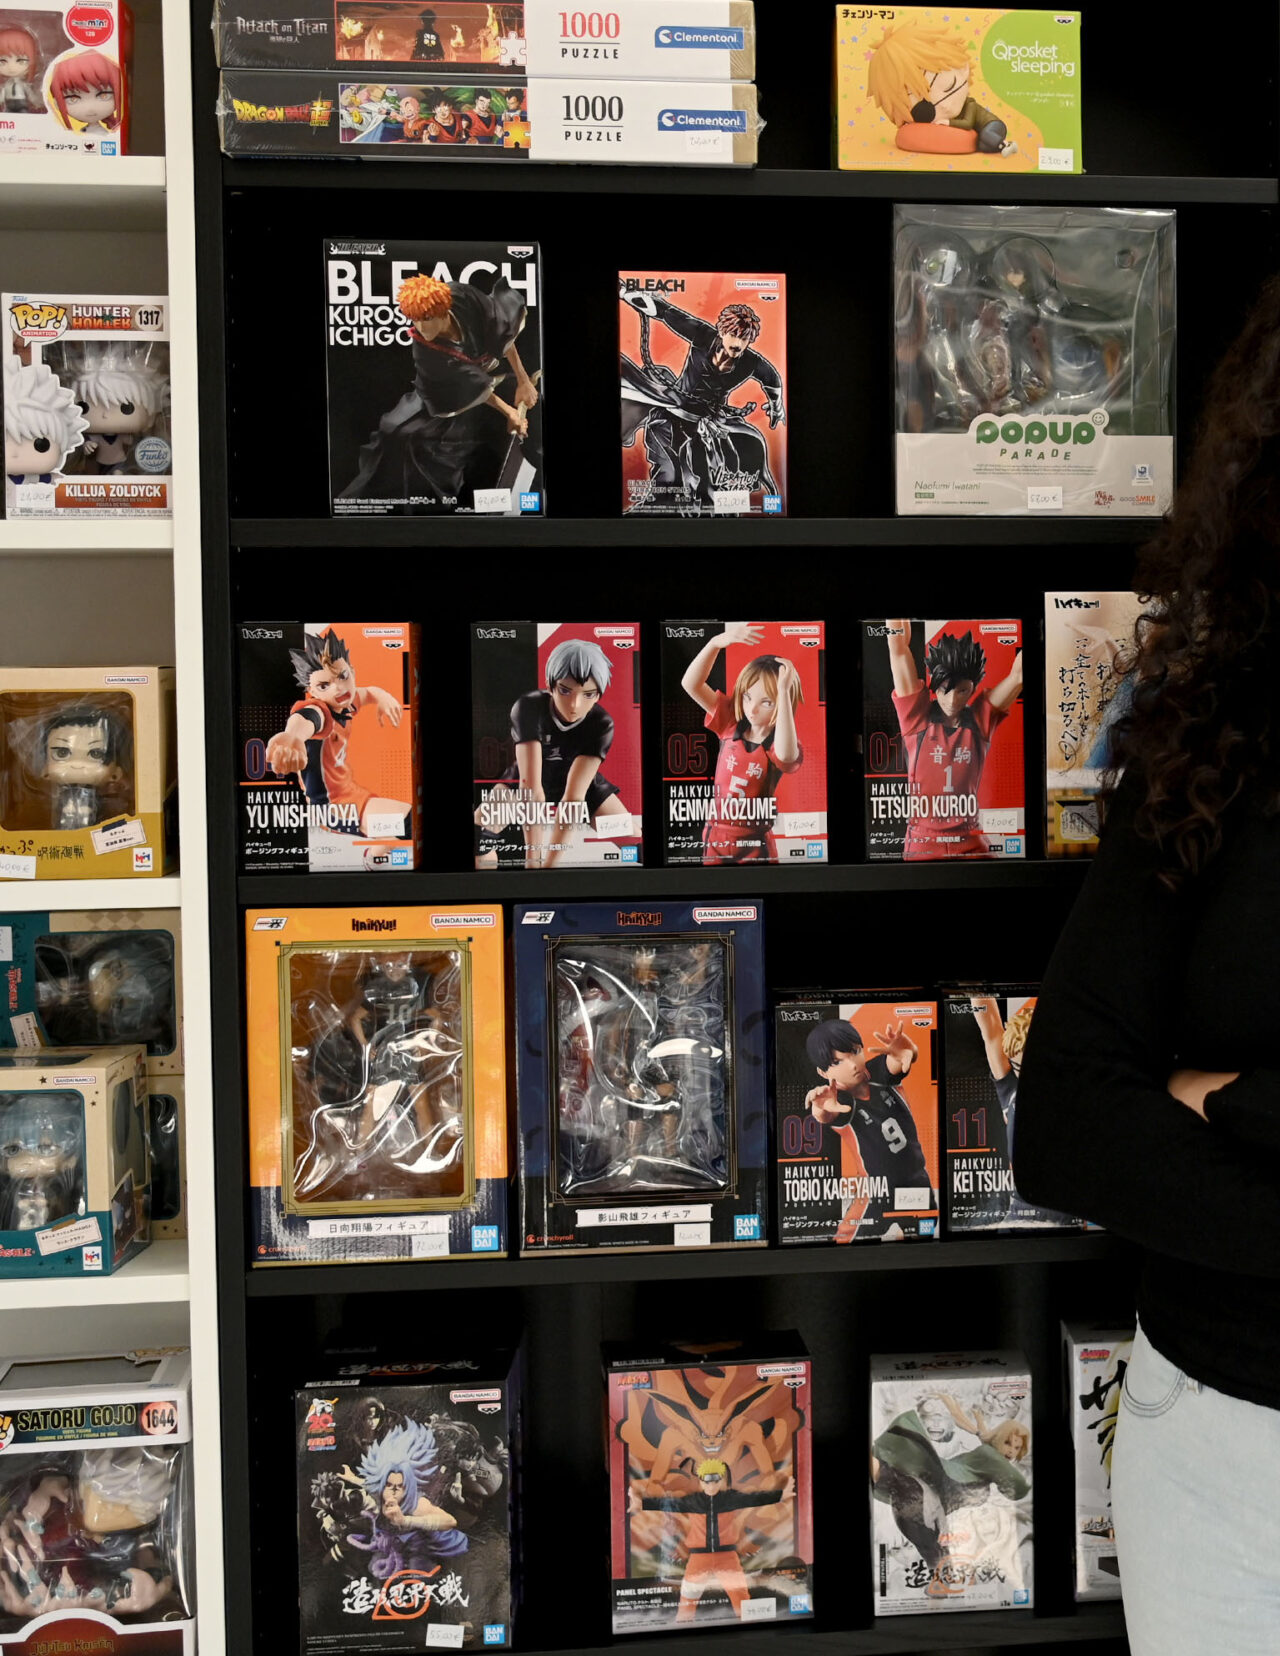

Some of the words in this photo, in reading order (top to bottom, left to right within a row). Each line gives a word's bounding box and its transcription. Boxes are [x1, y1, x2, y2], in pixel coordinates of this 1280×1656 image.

[842, 9, 895, 20] チェンソーマン
[236, 16, 279, 34] Attack
[282, 24, 292, 32] on
[294, 18, 328, 34] Titan
[558, 12, 620, 38] 1000
[674, 32, 738, 43] Clementoni
[562, 48, 618, 59] PUZZLE
[1012, 60, 1076, 76] sleeping
[233, 98, 284, 122] DRAGON
[563, 95, 624, 121] 1000
[677, 115, 741, 126] Clementoni
[565, 131, 622, 141] PUZZLE
[626, 279, 685, 292] BLEACH
[11, 304, 66, 330] POP!
[72, 305, 130, 317] HUNTER
[138, 310, 160, 326] 1317
[976, 420, 1096, 444] POPUP
[140, 450, 168, 460] Funko
[1000, 449, 1072, 461] PARADE
[711, 467, 760, 485] VIBRATION
[66, 485, 106, 497] KILLUA
[110, 485, 161, 497] ZOLDYCK
[915, 481, 950, 490] Naofumi
[952, 481, 982, 490] Iwatani
[520, 494, 538, 502] BAN
[668, 733, 708, 774] 05
[930, 745, 972, 764] 音駒
[943, 766, 954, 792] 1
[482, 789, 533, 801] HAIKYU!!
[670, 785, 720, 798] HAIKYU!!
[872, 784, 921, 795] HAIKYU!!
[247, 791, 299, 804] HAIKYU!!
[480, 802, 555, 825] SHINSUKE
[559, 801, 590, 824] KITA
[670, 798, 717, 821] KENMA
[721, 797, 776, 821] KOZUME
[871, 796, 928, 819] TETSURO
[932, 794, 977, 817] KUROO
[246, 805, 268, 828] YU
[273, 804, 360, 828] NISHINOYA
[434, 916, 462, 924] BANDAI
[463, 916, 491, 924] NAMCO
[953, 1108, 986, 1146] 11
[783, 1115, 822, 1155] 09
[881, 1117, 907, 1154] 9
[954, 1158, 1002, 1170] HAIKYU!!
[785, 1165, 834, 1178] HAIKYU!!
[784, 1180, 820, 1201] TOBIO
[824, 1176, 889, 1200] KAGEYAMA
[953, 1172, 973, 1193] KEI
[598, 1209, 691, 1223] 影山飛雄フィギュア
[736, 1218, 758, 1227] BAN
[474, 1229, 496, 1239] BAN
[736, 1227, 753, 1236] DAI
[474, 1239, 492, 1248] DAI
[18, 1408, 85, 1432] SATORU
[90, 1404, 136, 1426] GOJO
[145, 1409, 174, 1429] 1644
[616, 1588, 637, 1596] PANEL
[638, 1586, 672, 1595] SPECTACLE
[486, 1634, 500, 1642] DAI
